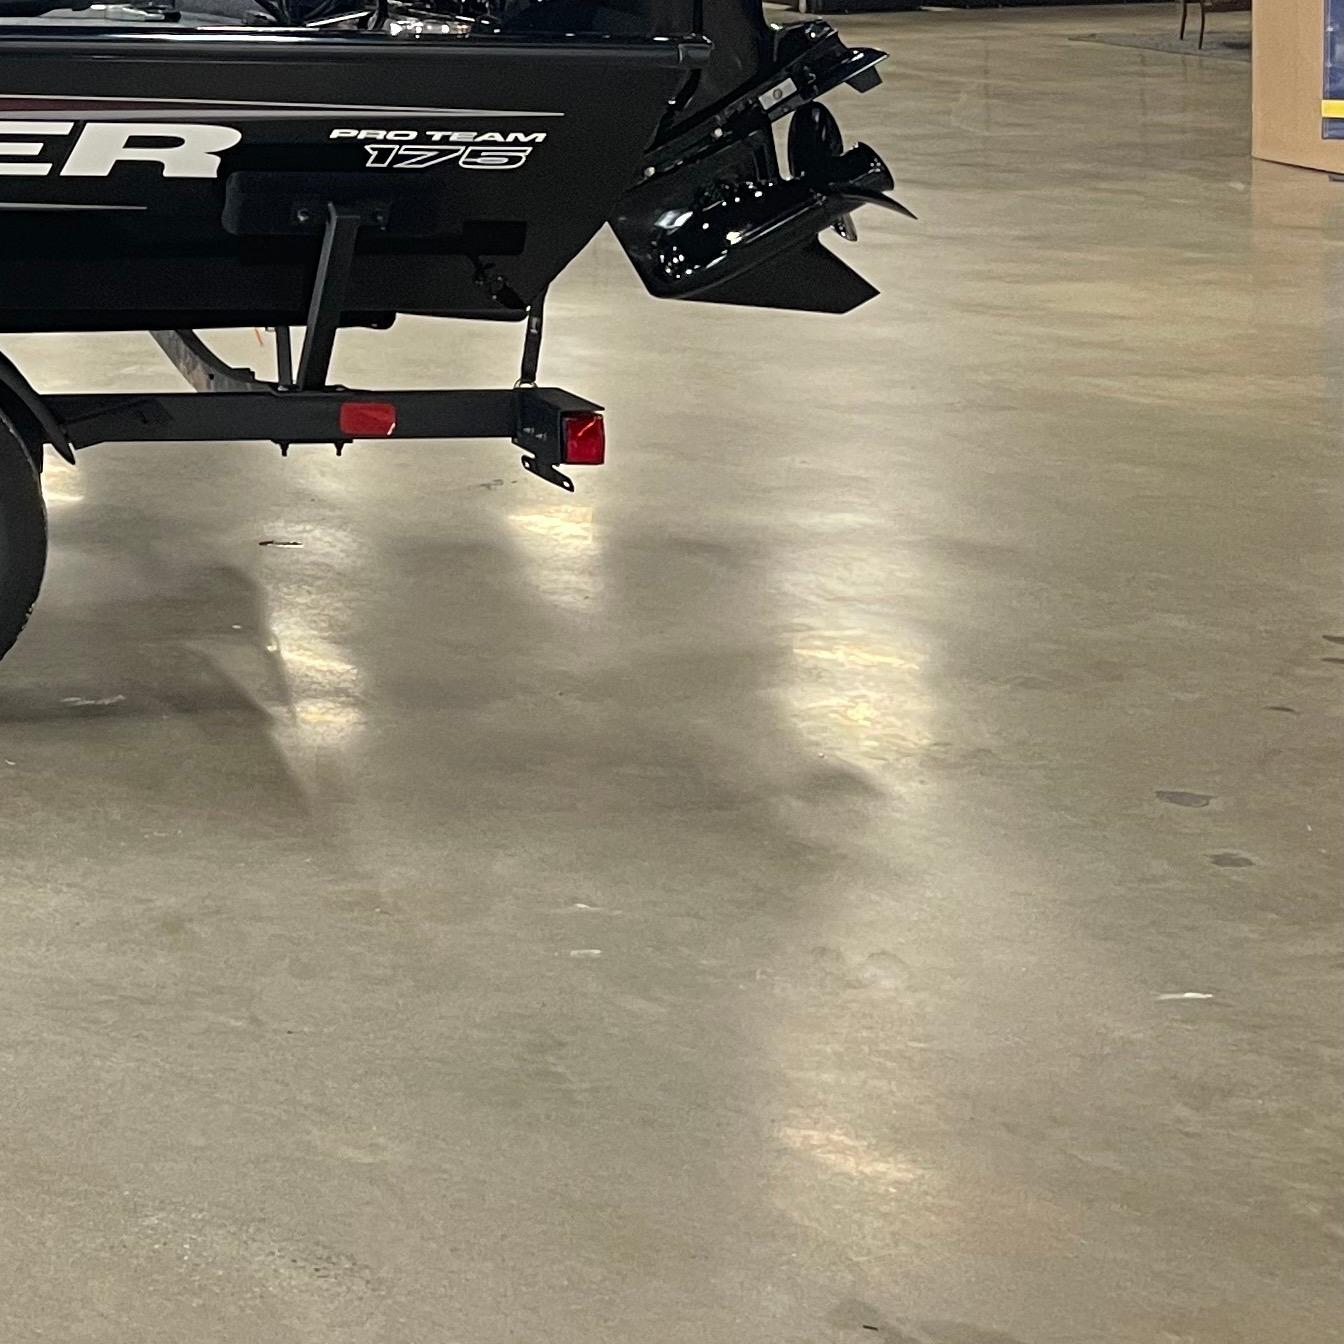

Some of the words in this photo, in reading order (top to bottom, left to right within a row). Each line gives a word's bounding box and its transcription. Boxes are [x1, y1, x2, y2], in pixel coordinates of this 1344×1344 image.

[329, 128, 419, 141] PRO
[425, 130, 548, 143] TEAM
[364, 144, 533, 170] 175
